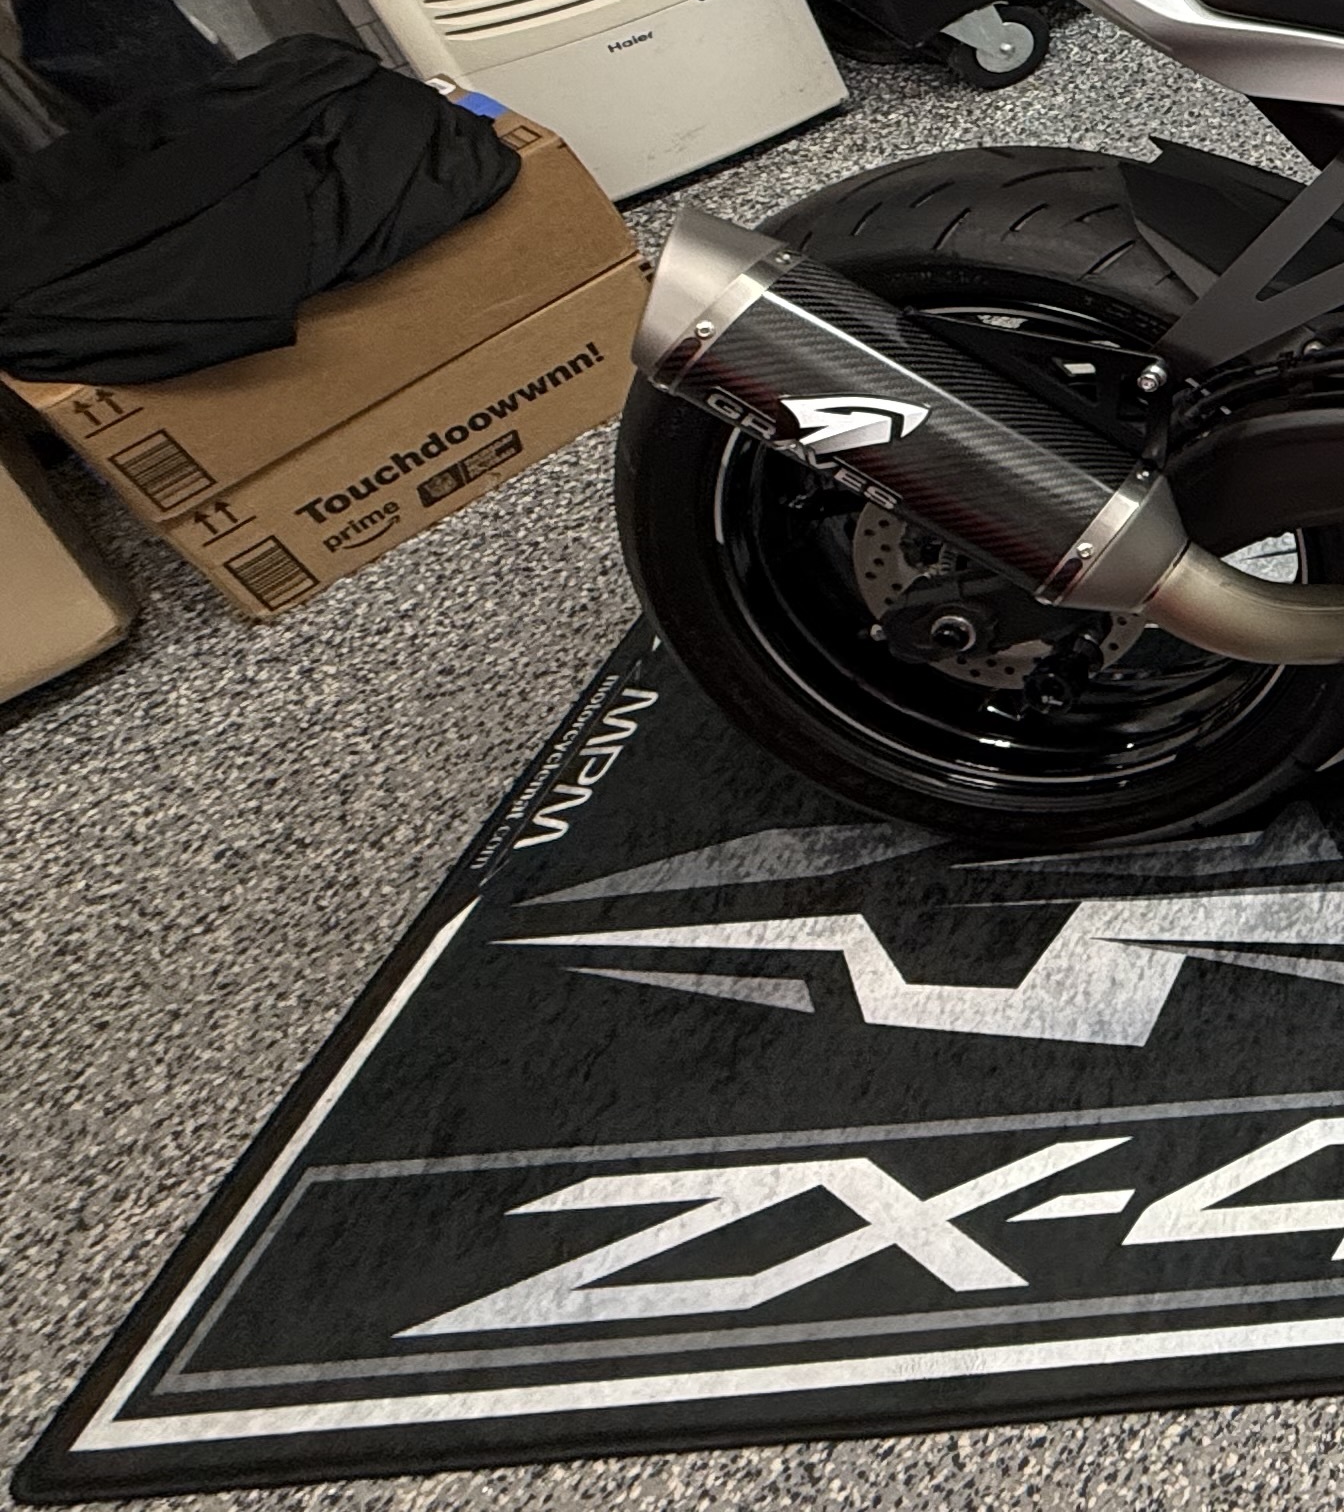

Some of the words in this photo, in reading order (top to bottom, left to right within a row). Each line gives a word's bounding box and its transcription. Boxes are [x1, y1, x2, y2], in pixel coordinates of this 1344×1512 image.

[606, 30, 655, 54] Haier
[294, 341, 605, 525] Touchdoowwnn!
[321, 499, 400, 553] prime
[513, 687, 660, 850] MPM
